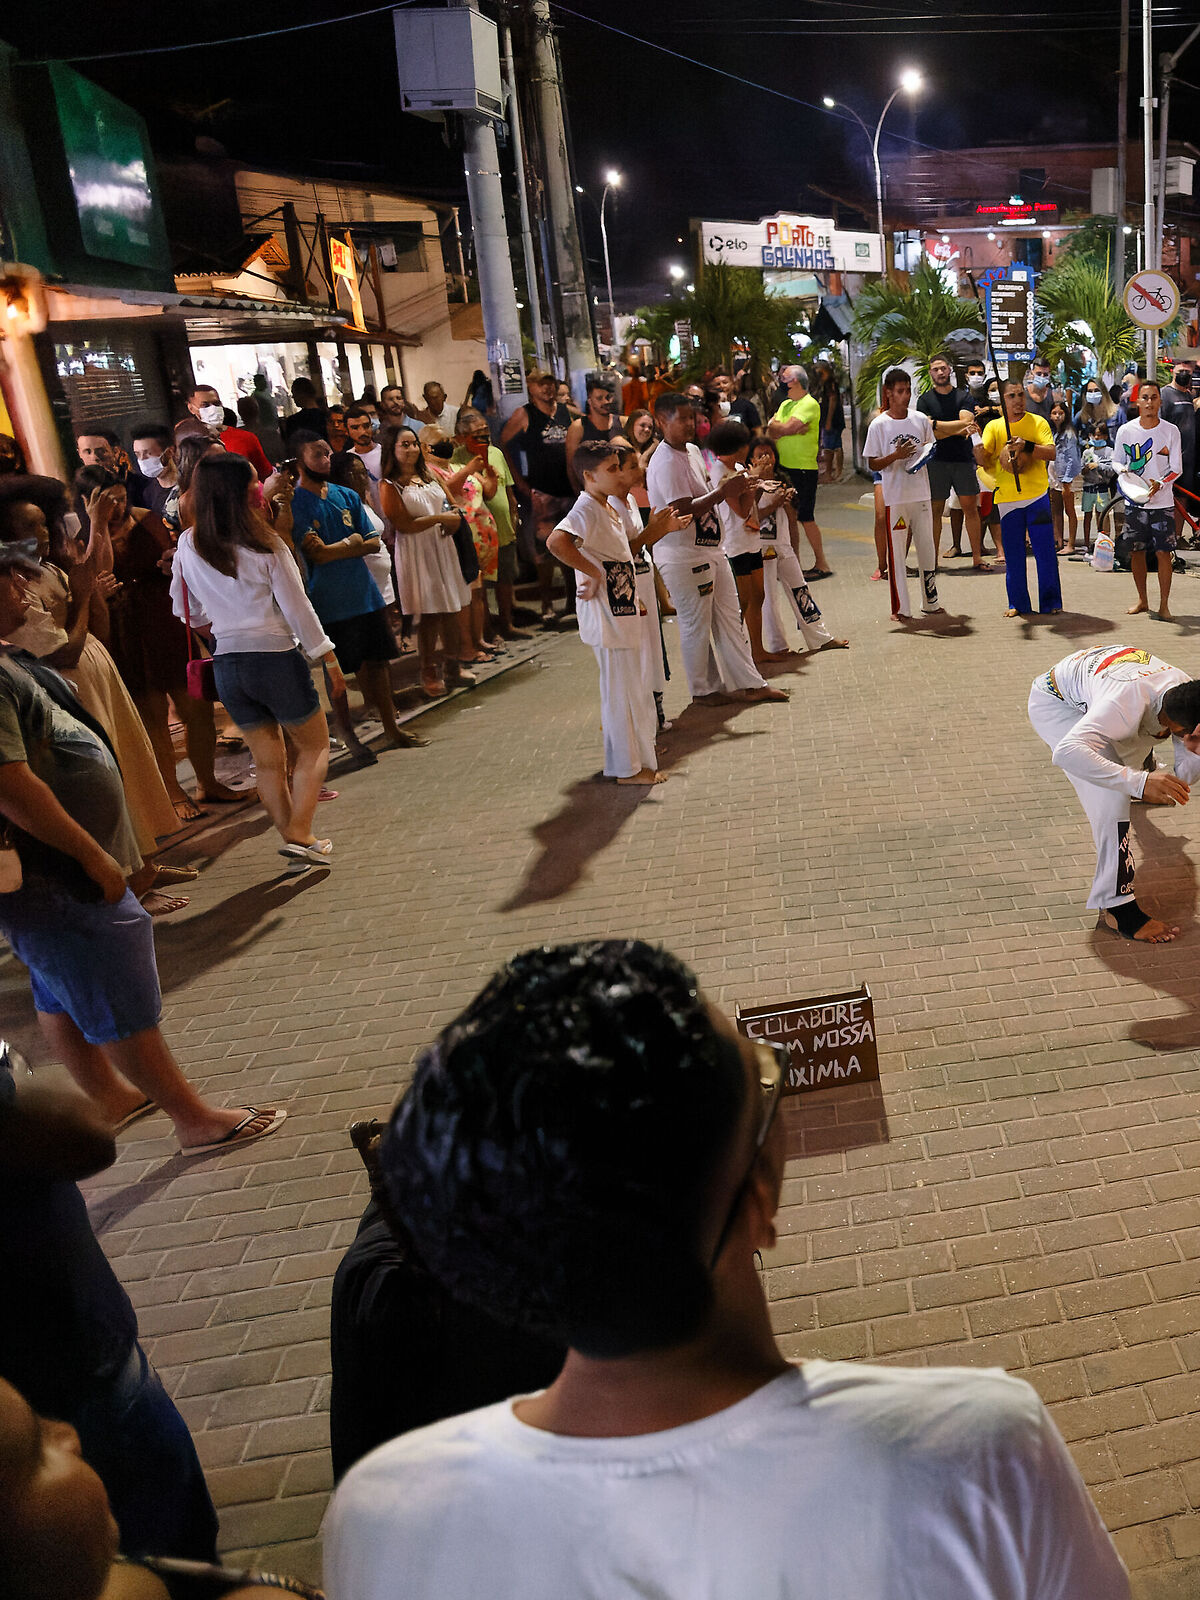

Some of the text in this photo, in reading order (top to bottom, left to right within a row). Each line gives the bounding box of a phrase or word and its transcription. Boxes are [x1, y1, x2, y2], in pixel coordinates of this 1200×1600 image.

[766, 221, 831, 248] PORTO DE
[761, 245, 835, 270] GALINHAS
[746, 1001, 864, 1039] COLABORE
[813, 1020, 874, 1052] NOSSA
[788, 1055, 862, 1087] IXINHA
